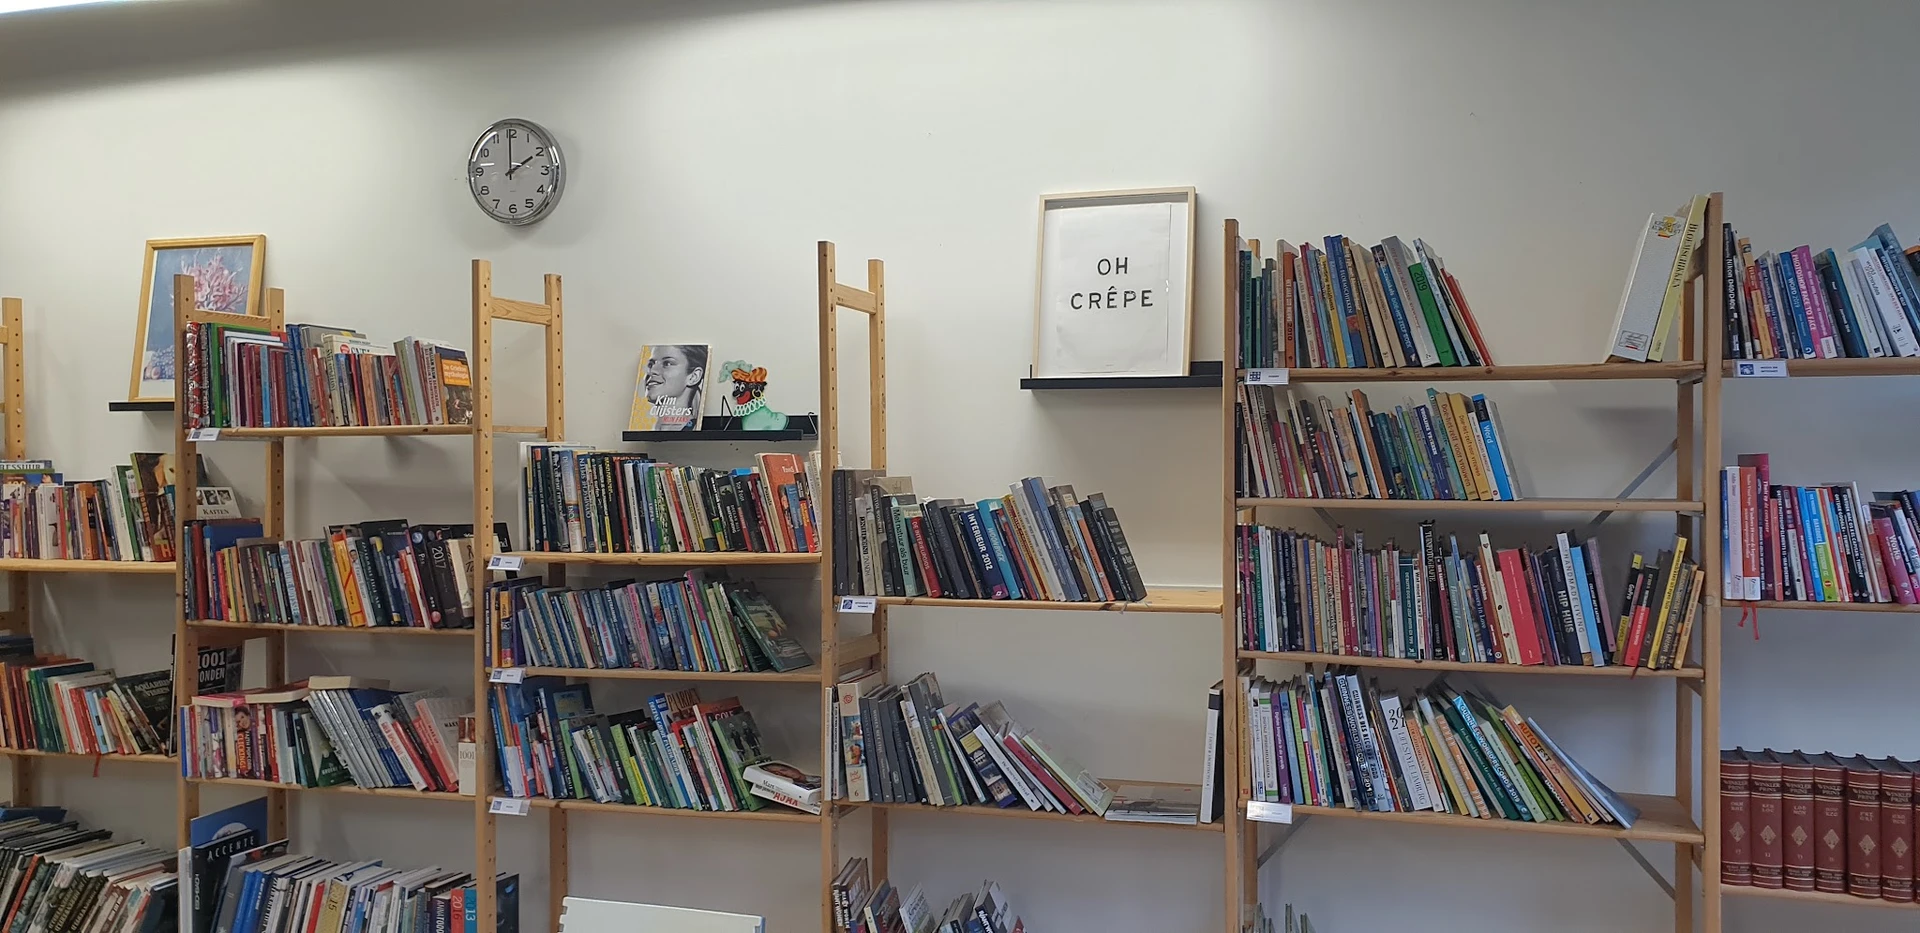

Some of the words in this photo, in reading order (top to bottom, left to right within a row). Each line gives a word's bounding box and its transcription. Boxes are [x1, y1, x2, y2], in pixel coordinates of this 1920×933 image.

[492, 134, 500, 144] 11
[506, 129, 517, 139] 12
[526, 133, 530, 143] 1
[480, 148, 490, 158] 10
[535, 146, 545, 157] 2
[475, 167, 484, 177] 9
[540, 165, 550, 176] 3
[480, 185, 490, 195] 8
[536, 184, 545, 194] 4
[492, 199, 501, 209] 7
[508, 204, 518, 214] 6
[524, 199, 534, 208] 5
[1672, 223, 1698, 288] BLOEMSCHIKKEN
[1097, 257, 1129, 275] OH
[1726, 258, 1735, 279] Nikon
[1413, 271, 1428, 292] 2019
[1788, 277, 1798, 296] WORD
[1070, 285, 1153, 310] CRÊPE
[1791, 254, 1804, 290] PHOTOSHOP
[1802, 290, 1810, 305] FACE
[1808, 316, 1816, 331] FACE
[655, 395, 677, 405] Kim
[650, 405, 693, 418] Clijsters
[1483, 425, 1494, 444] Word
[892, 508, 902, 521] Met
[911, 521, 919, 530] DE
[894, 524, 905, 547] natuur
[967, 513, 987, 553] INTERIEUR
[981, 553, 994, 571] 2012
[1888, 534, 1901, 560] Works
[430, 545, 447, 571] 2017
[901, 559, 910, 575] buur
[1557, 590, 1570, 607] HIP
[1563, 553, 1579, 601] HANDMADE
[1573, 604, 1585, 633] LIVING
[1626, 583, 1635, 600] GoPro
[1561, 609, 1574, 633] HUIS
[199, 668, 225, 686] ONDEN
[1388, 708, 1403, 721] 20
[1339, 679, 1353, 716] GUINNESS
[1347, 715, 1359, 743] WORLD
[1355, 743, 1368, 777] RECORDS
[1391, 718, 1406, 731] 21
[237, 733, 247, 768] CLICKING!
[1460, 705, 1482, 737] GUINNESS
[1478, 736, 1496, 760] WORLD
[1492, 760, 1512, 788] RECORDS
[1518, 722, 1552, 763] AUTOTEST
[1398, 732, 1417, 772] LIFESTYLE
[1408, 771, 1428, 805] LIMBURG
[773, 792, 799, 806] AJAX
[853, 788, 860, 798] 6
[451, 896, 463, 920] 2016
